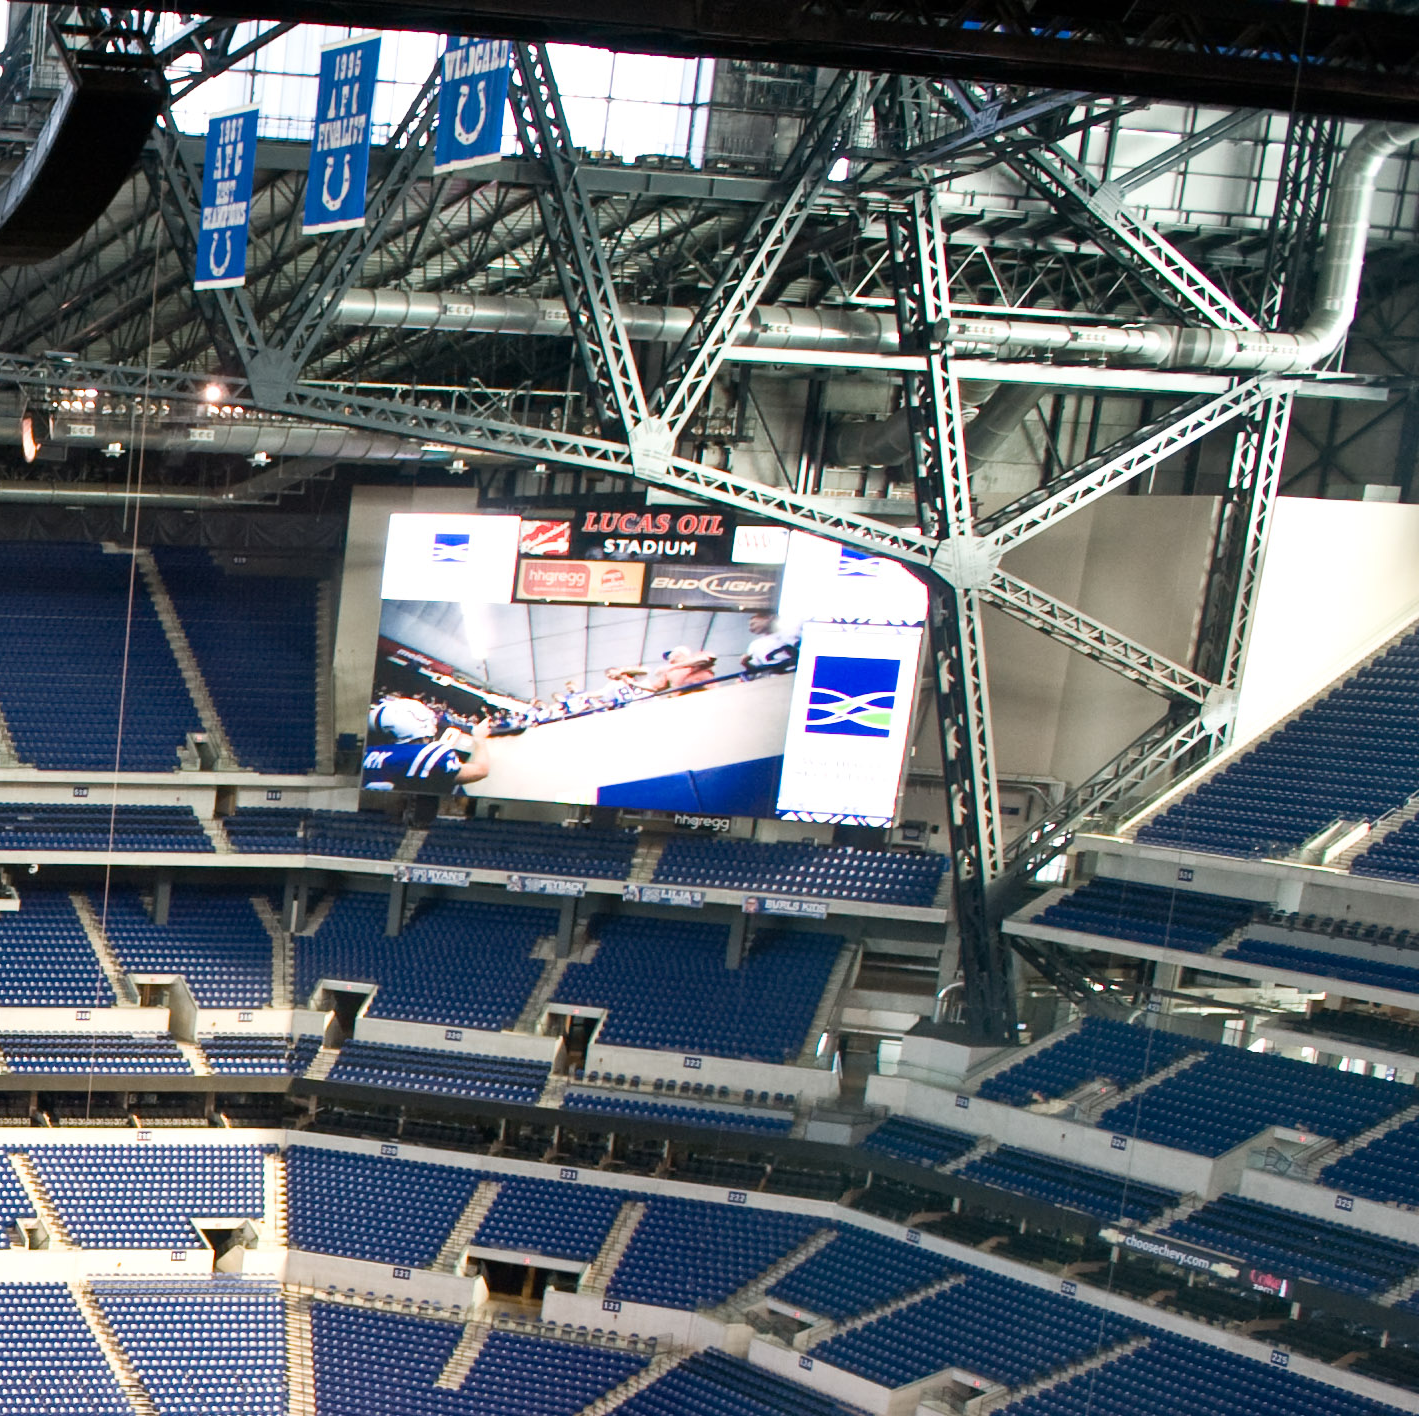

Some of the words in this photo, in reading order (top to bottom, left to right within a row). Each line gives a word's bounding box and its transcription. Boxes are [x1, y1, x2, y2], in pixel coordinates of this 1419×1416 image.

[333, 49, 363, 82] 1995
[443, 38, 511, 83] WILDCARD
[326, 82, 360, 119] AFC
[316, 113, 367, 152] FINALIST
[213, 141, 244, 180] AFC
[581, 511, 671, 535] LUCAS
[677, 513, 725, 536] OIL
[603, 538, 697, 557] STADIUM
[528, 569, 586, 587] hhgregg
[650, 575, 700, 590] BUD
[710, 578, 776, 593] LIGHT
[364, 751, 393, 770] RK
[674, 812, 731, 831] hhgregg
[1111, 1138, 1126, 1148] 324
[560, 1170, 576, 1179] 221
[1335, 1197, 1352, 1209] 325
[1125, 1234, 1210, 1269] choosechevy.com
[1249, 1268, 1281, 1290] Coke
[1271, 1352, 1288, 1364] 225
